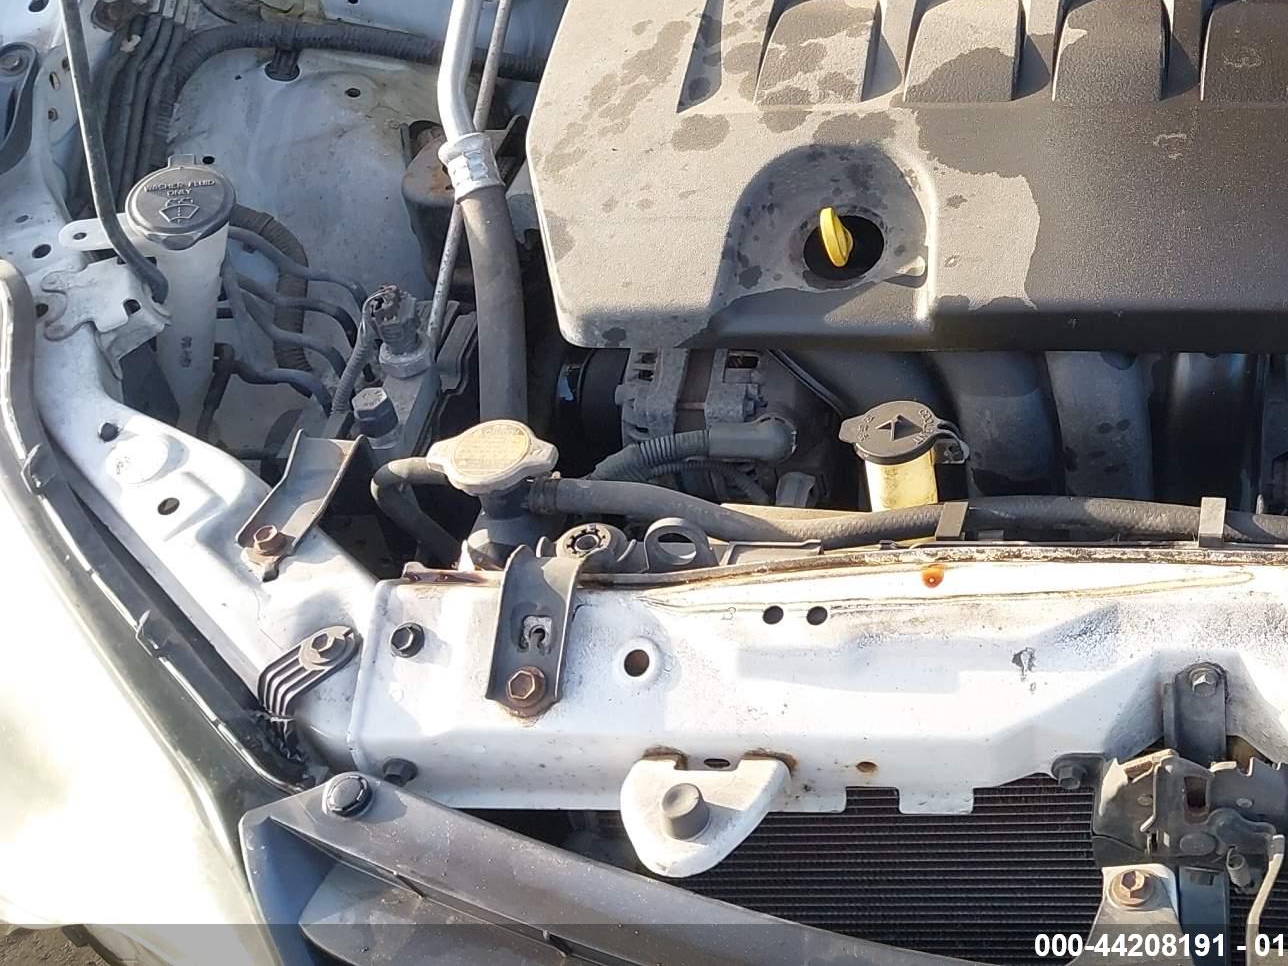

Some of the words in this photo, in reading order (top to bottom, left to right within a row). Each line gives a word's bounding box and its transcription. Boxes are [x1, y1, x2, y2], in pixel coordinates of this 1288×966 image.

[143, 182, 185, 192] WASHER
[188, 179, 216, 188] FLUID
[166, 188, 192, 196] ONLY
